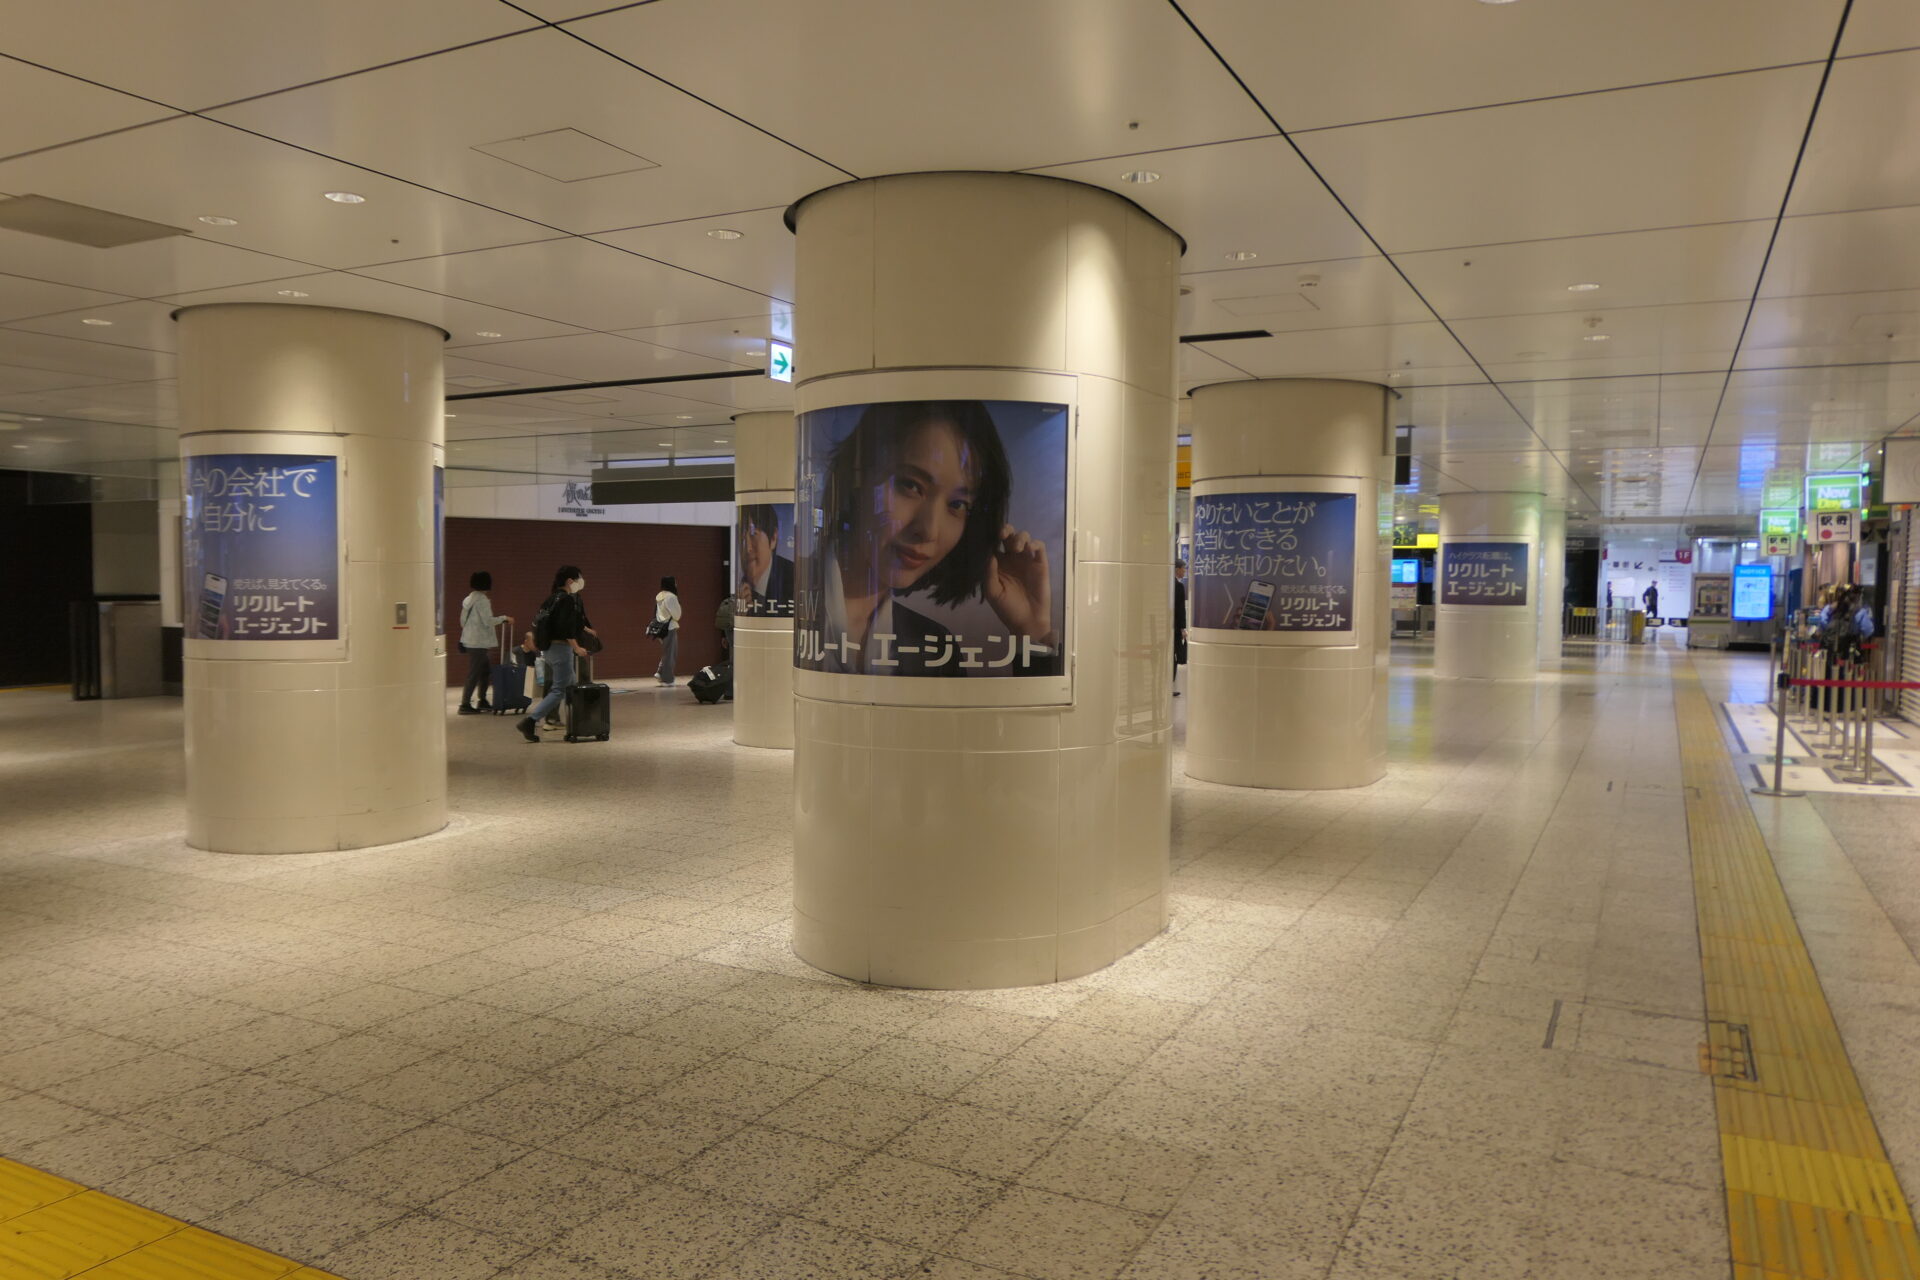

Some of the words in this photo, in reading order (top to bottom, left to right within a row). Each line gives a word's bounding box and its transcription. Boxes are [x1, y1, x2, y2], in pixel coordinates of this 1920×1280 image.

[1195, 501, 1316, 525] やりたいことが
[1195, 528, 1298, 550] 本当にできる
[1194, 554, 1326, 577] 会社を知りたい。
[1448, 563, 1514, 578] リクルート
[1448, 581, 1523, 596] エージェント
[234, 596, 314, 612] リクルート
[1281, 598, 1339, 611] リクルート
[234, 617, 328, 634] エージェント
[1280, 614, 1347, 627] エージェント
[871, 633, 1054, 668] エージェント
